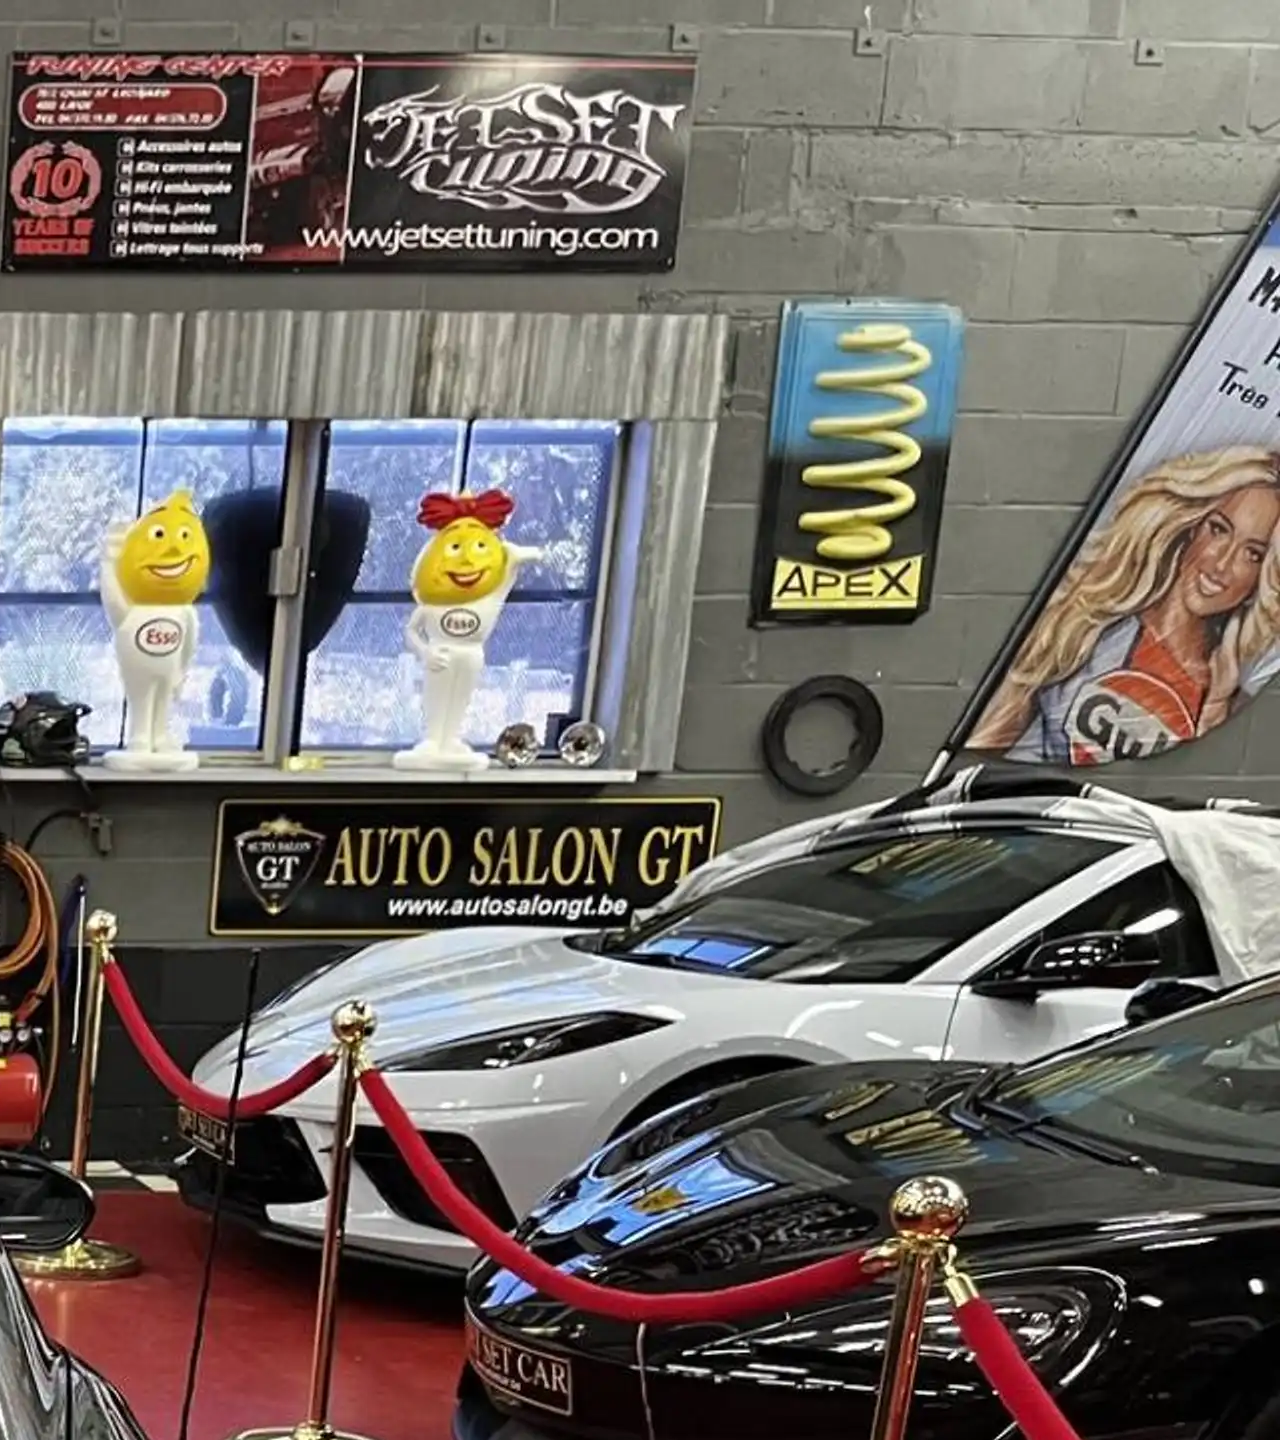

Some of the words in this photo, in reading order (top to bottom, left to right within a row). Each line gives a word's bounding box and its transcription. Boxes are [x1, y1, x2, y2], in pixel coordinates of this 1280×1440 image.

[32, 158, 84, 199] 10
[136, 161, 160, 174] Kits
[301, 219, 659, 256] www.jetsettuning.com
[777, 561, 912, 597] APEX
[145, 627, 178, 645] Esso
[446, 617, 475, 631] Esso
[256, 855, 300, 881] GT
[325, 826, 453, 886] AUTO
[468, 826, 623, 887] SALON
[637, 825, 706, 886] GT
[387, 895, 628, 920] www.autosalongt.be
[517, 1352, 569, 1394] CAR
